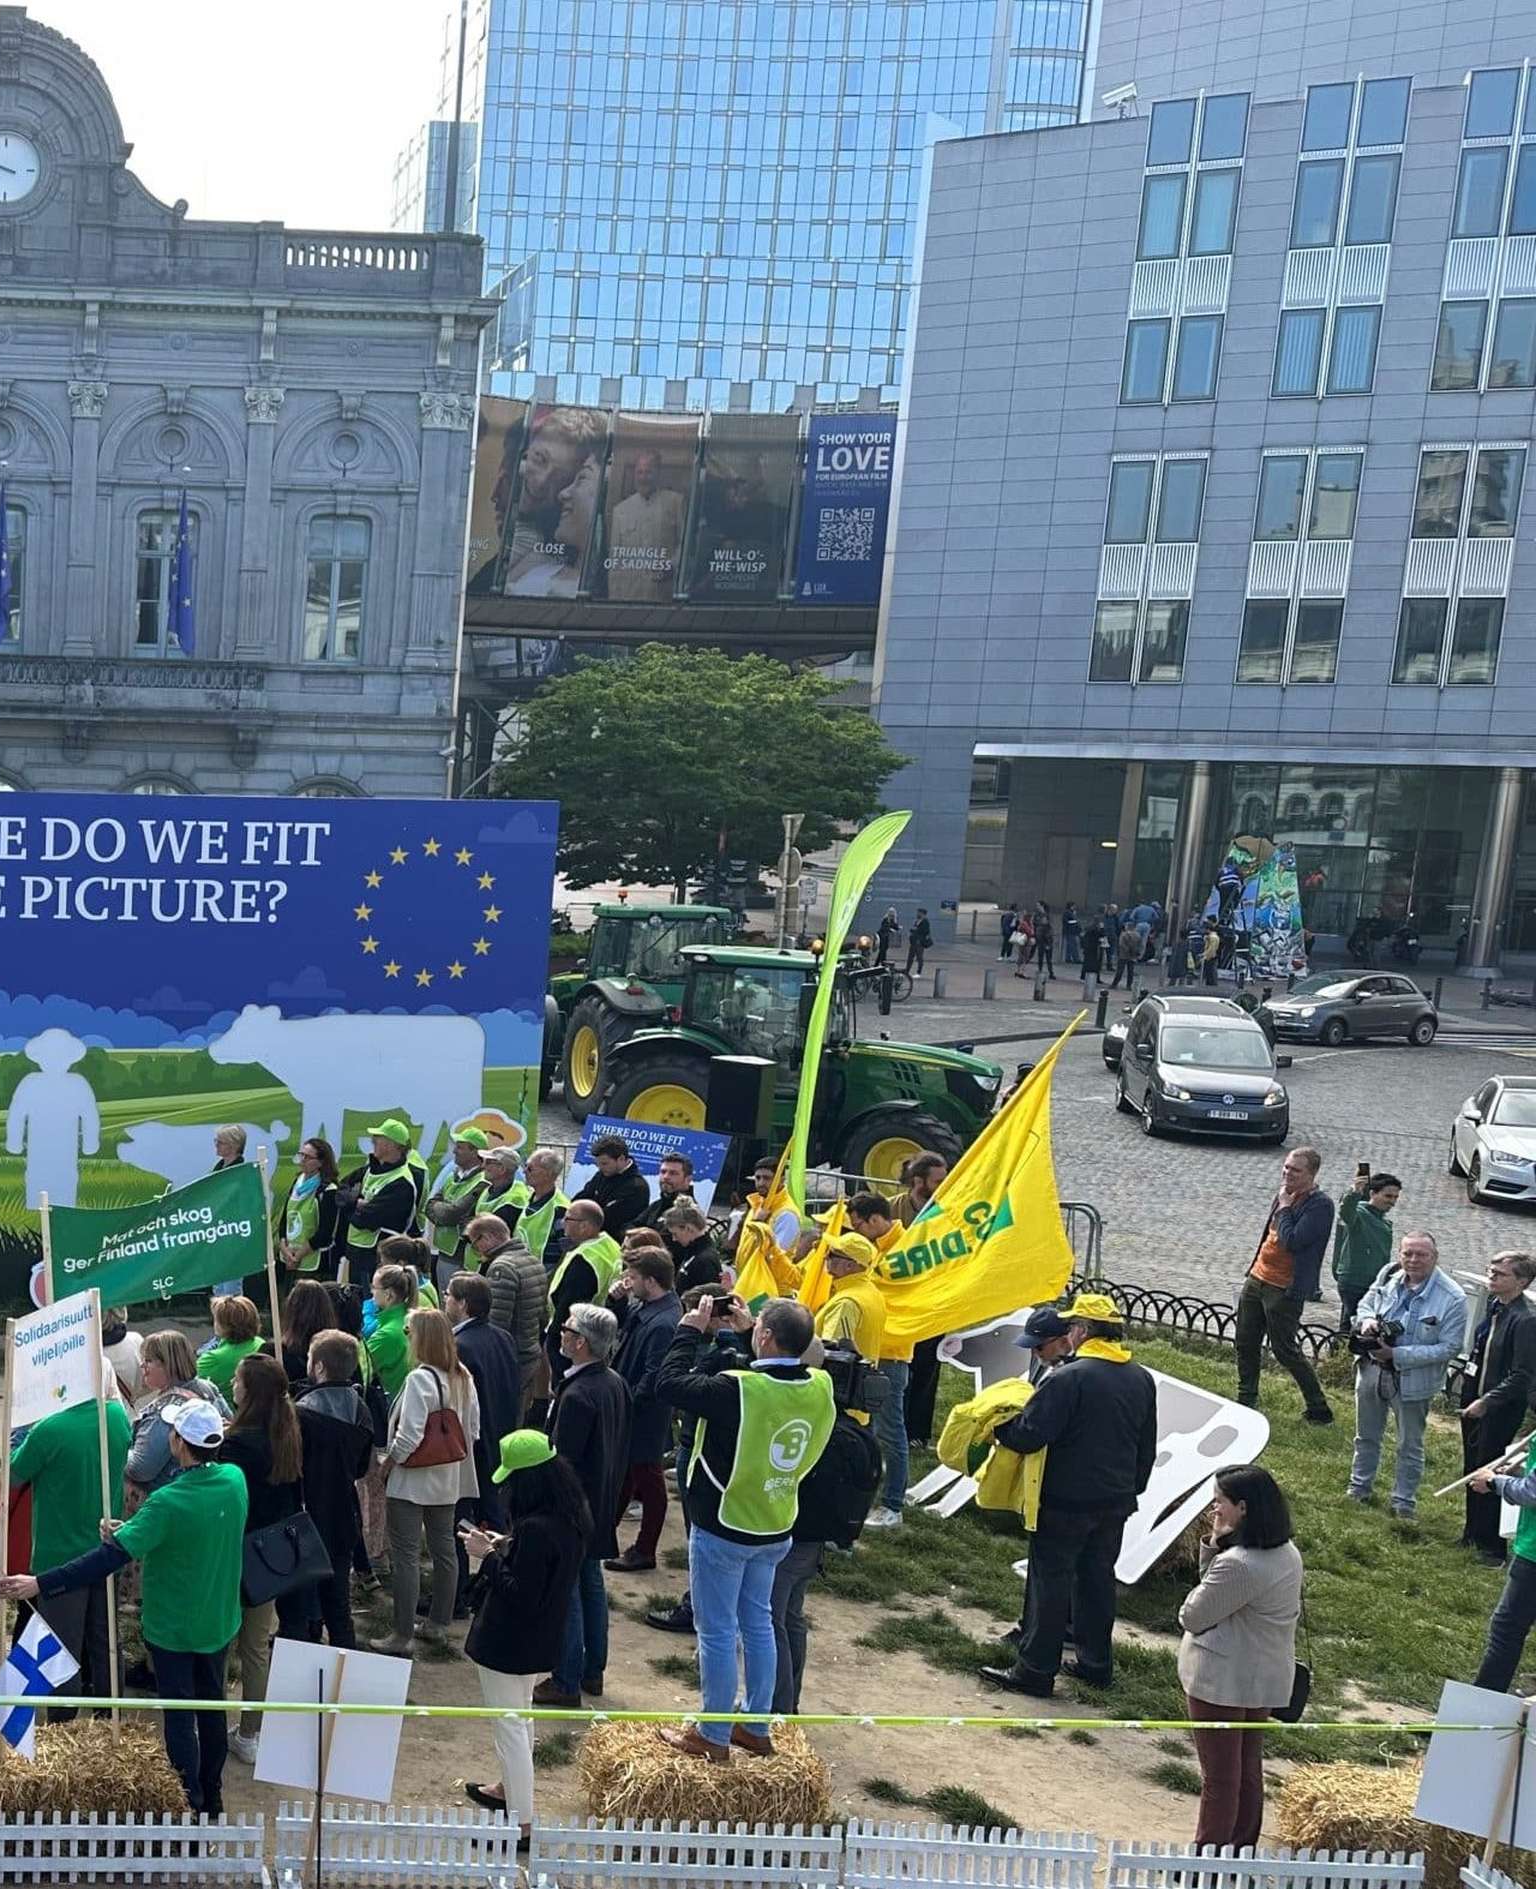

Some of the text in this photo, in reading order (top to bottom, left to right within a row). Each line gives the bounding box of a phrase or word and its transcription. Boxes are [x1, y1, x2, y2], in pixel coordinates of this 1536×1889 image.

[819, 432, 891, 445] SHOW YOUR
[816, 446, 890, 471] LOVE
[831, 473, 868, 481] EUROPEAN
[870, 472, 888, 480] FILM
[534, 542, 565, 555] CLOSE
[613, 547, 667, 559] TRIANGLE
[604, 557, 672, 571] OF SADNESS
[709, 561, 767, 573] THE-WISP
[40, 817, 126, 863] DO
[138, 820, 228, 864] WE
[241, 821, 330, 866] FIT
[19, 875, 288, 923] PICTURE?
[592, 1123, 685, 1146] WHERE DO WE FIT
[102, 1207, 212, 1249] Mat och skog
[64, 1219, 251, 1273] ger Finland framgång
[152, 1276, 175, 1290] SLC
